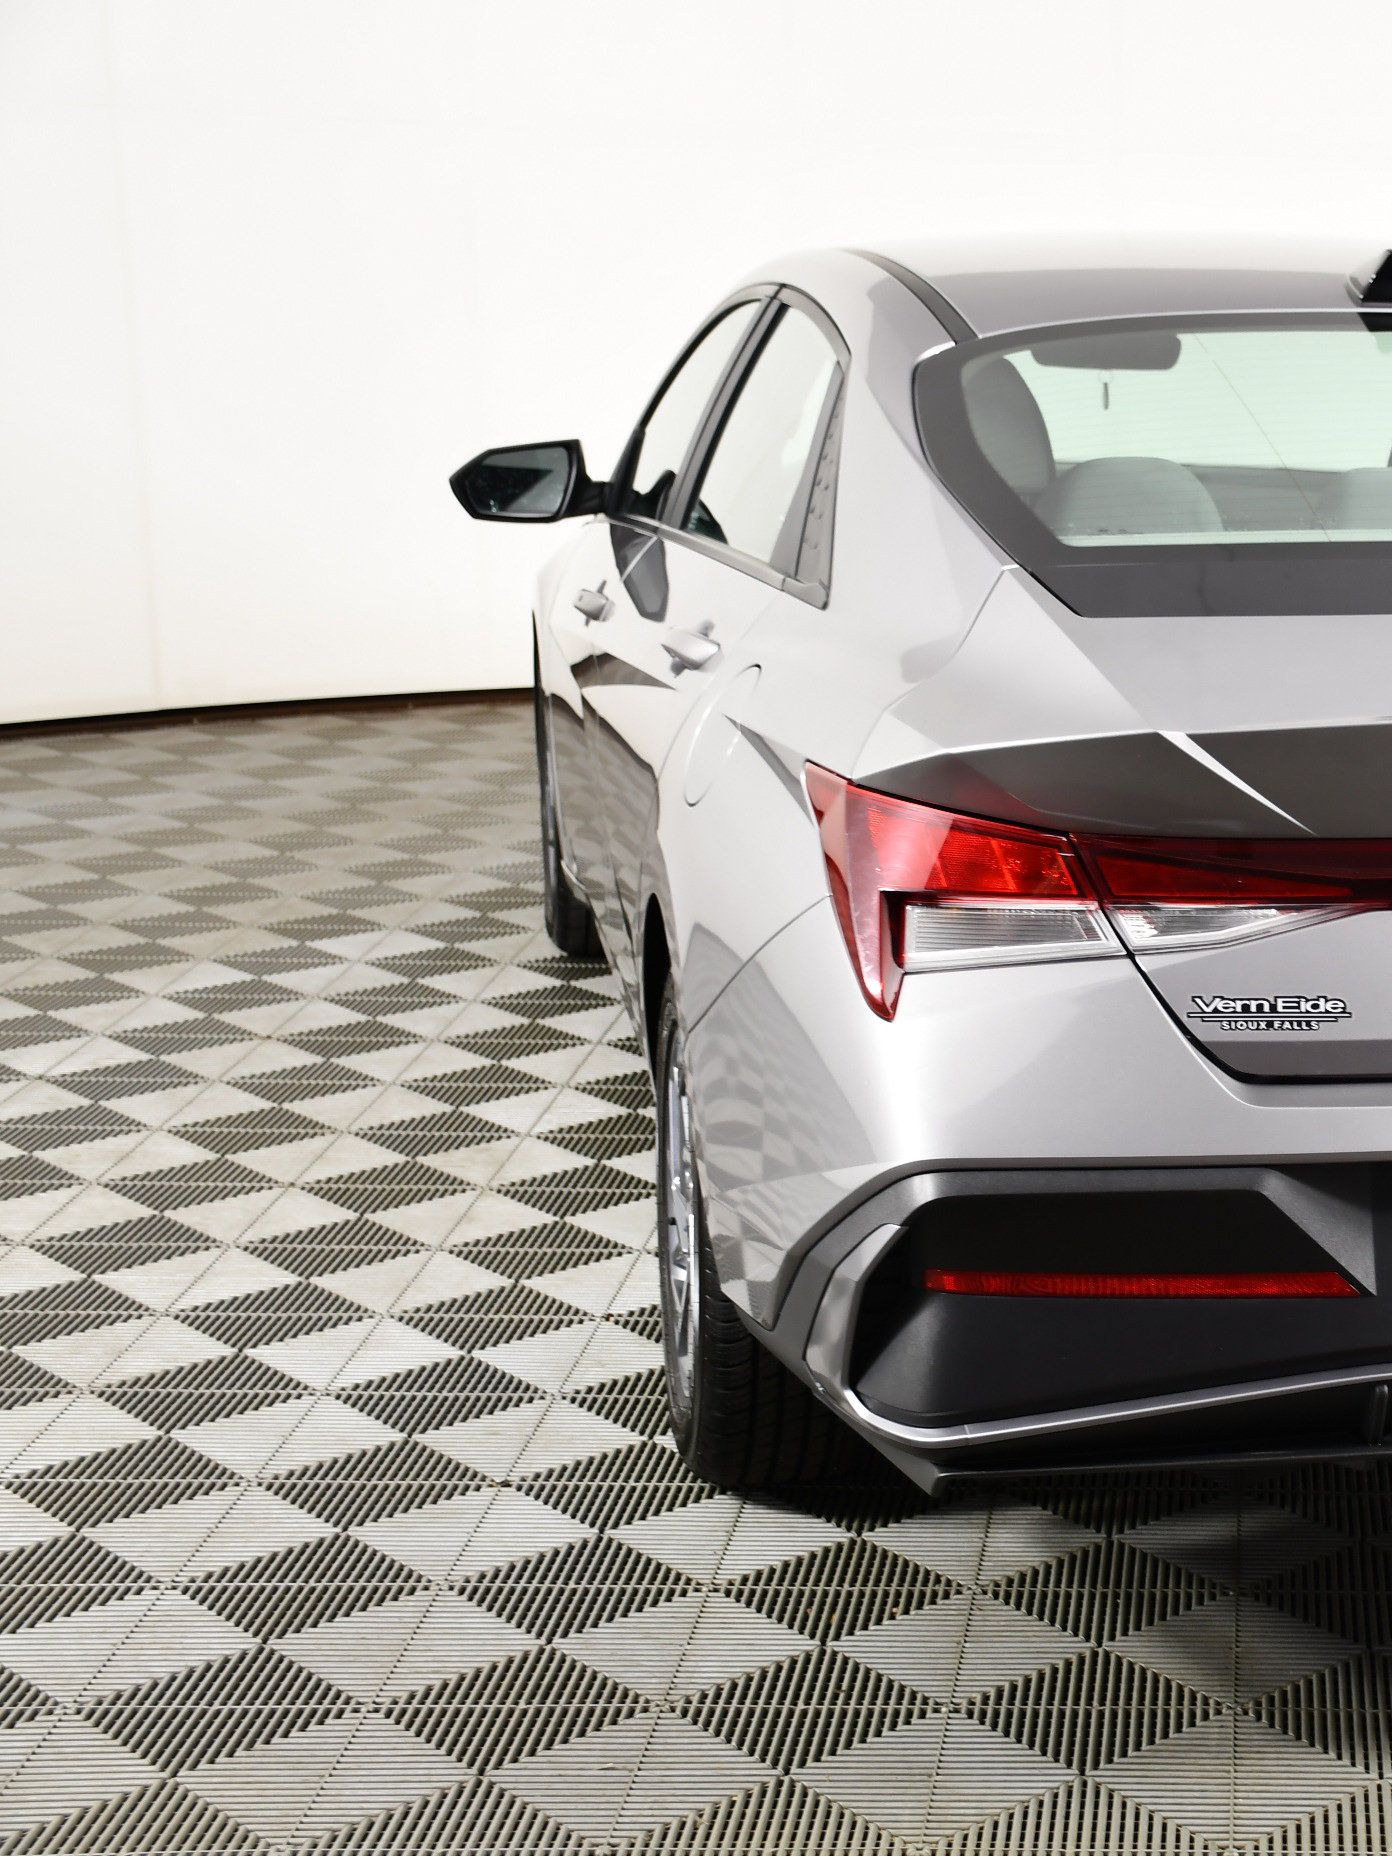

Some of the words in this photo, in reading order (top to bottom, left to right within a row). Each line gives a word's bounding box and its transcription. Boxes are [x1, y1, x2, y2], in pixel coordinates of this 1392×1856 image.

[1193, 997, 1270, 1013] Vern
[1276, 997, 1346, 1013] Eide
[1221, 1020, 1268, 1031] SIOUX
[1273, 1020, 1320, 1030] FALLS
